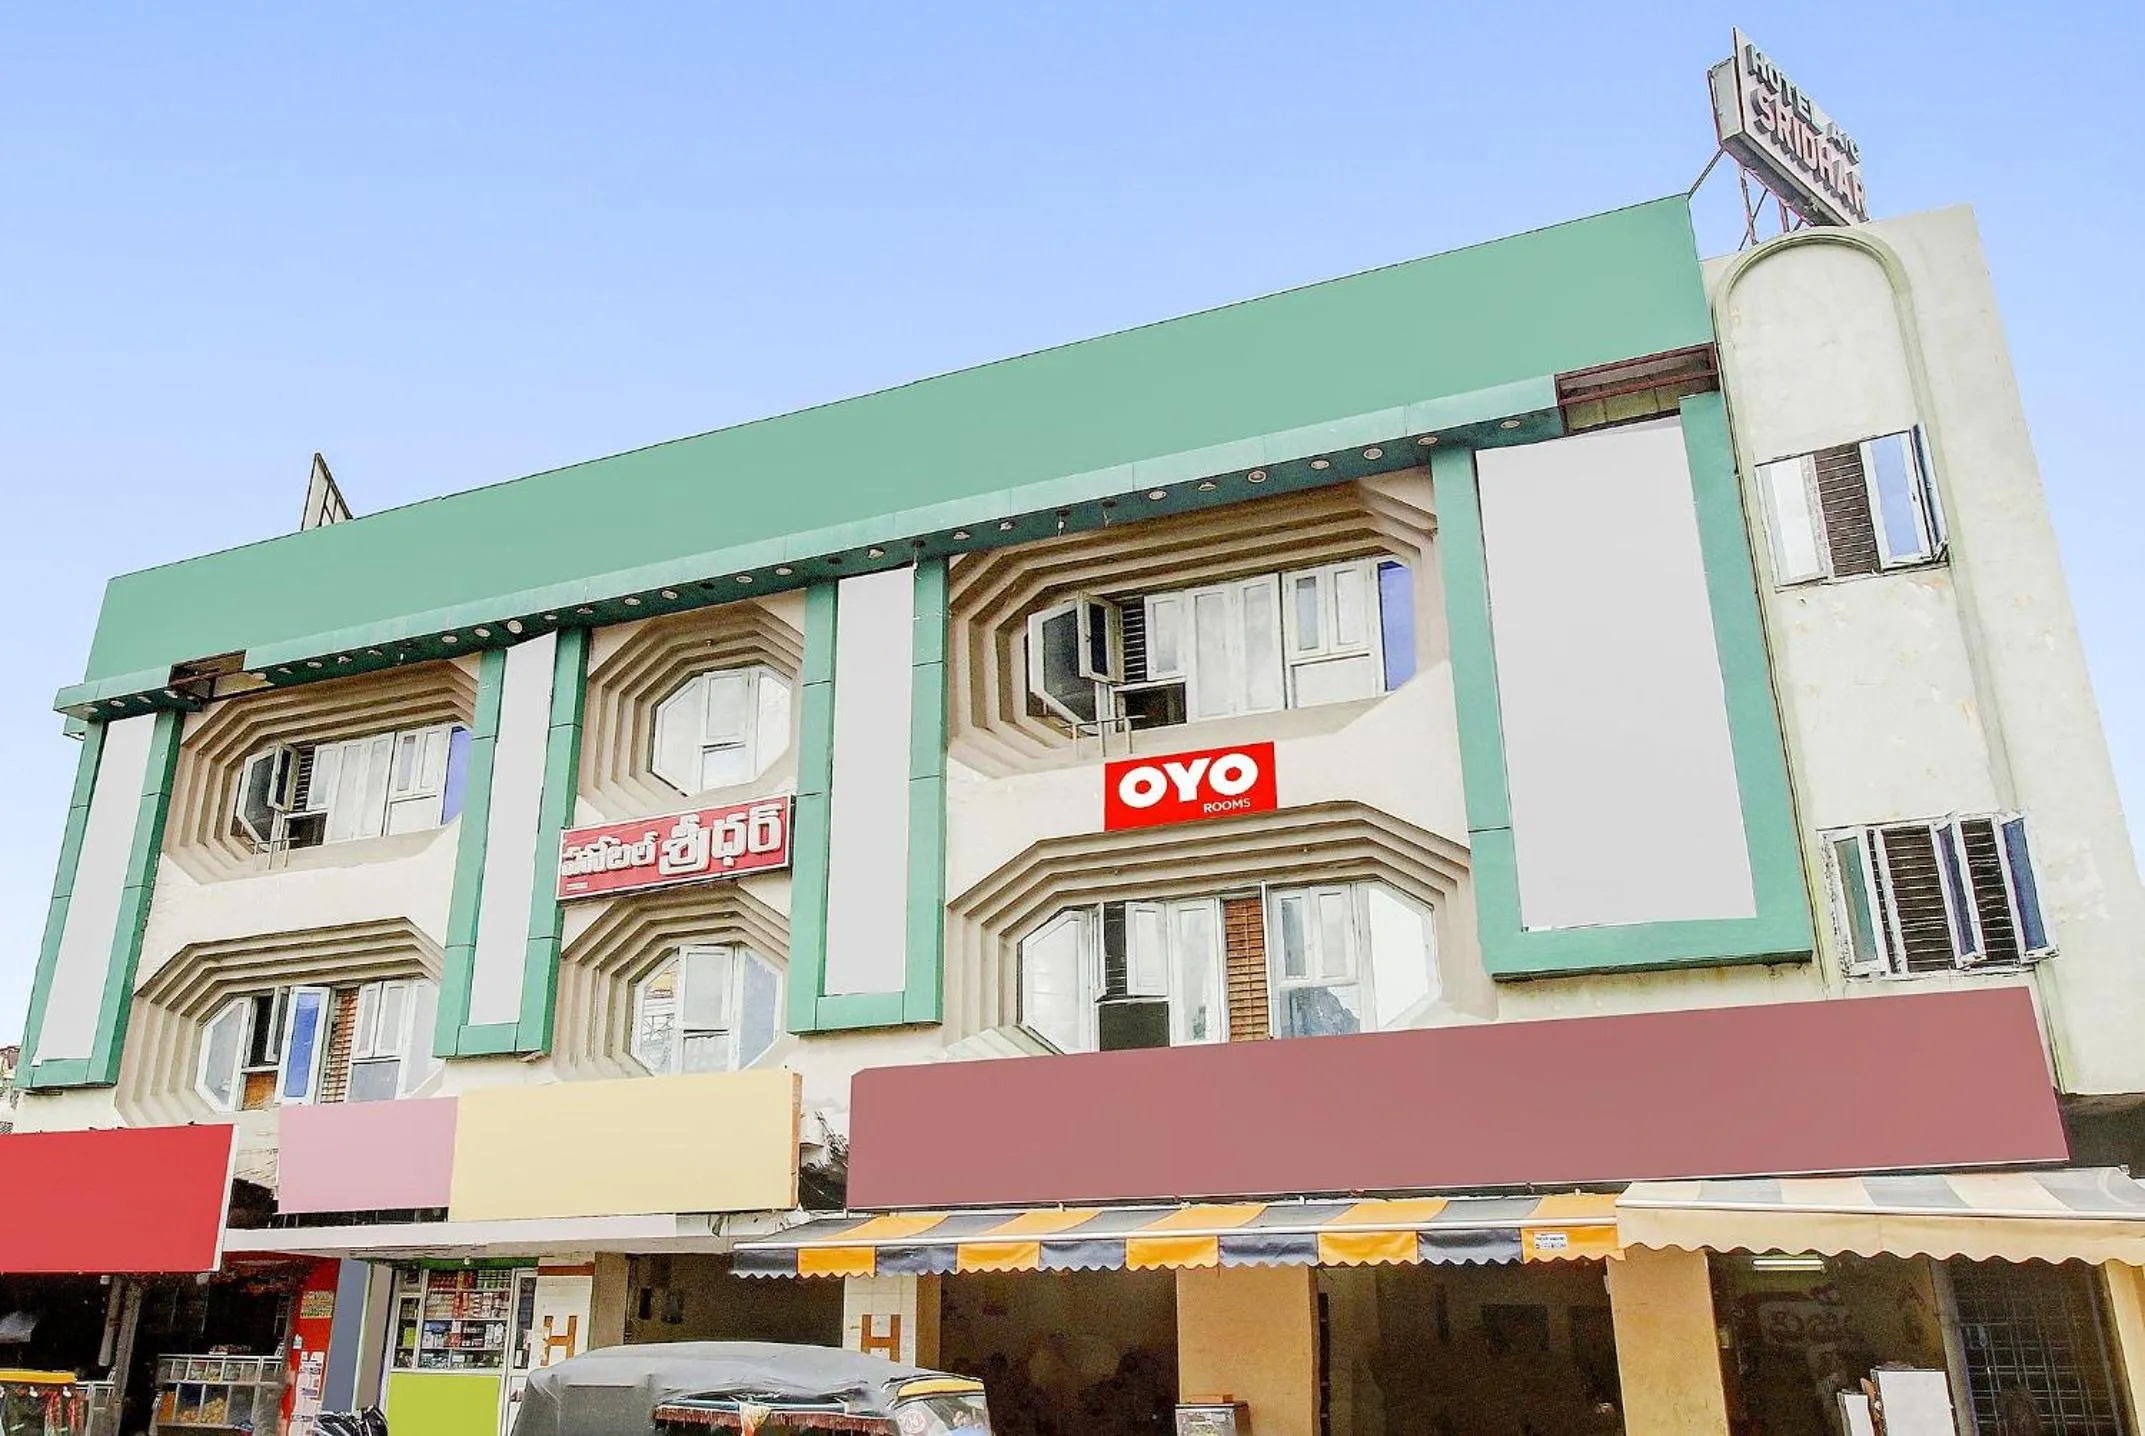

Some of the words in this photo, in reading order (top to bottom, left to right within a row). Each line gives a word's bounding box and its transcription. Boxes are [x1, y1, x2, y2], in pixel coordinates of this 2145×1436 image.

[1745, 43, 1822, 136] HOTEL
[1750, 88, 1870, 223] SRIDHAR
[1118, 752, 1259, 809] OYO
[1203, 798, 1251, 813] ROOMS
